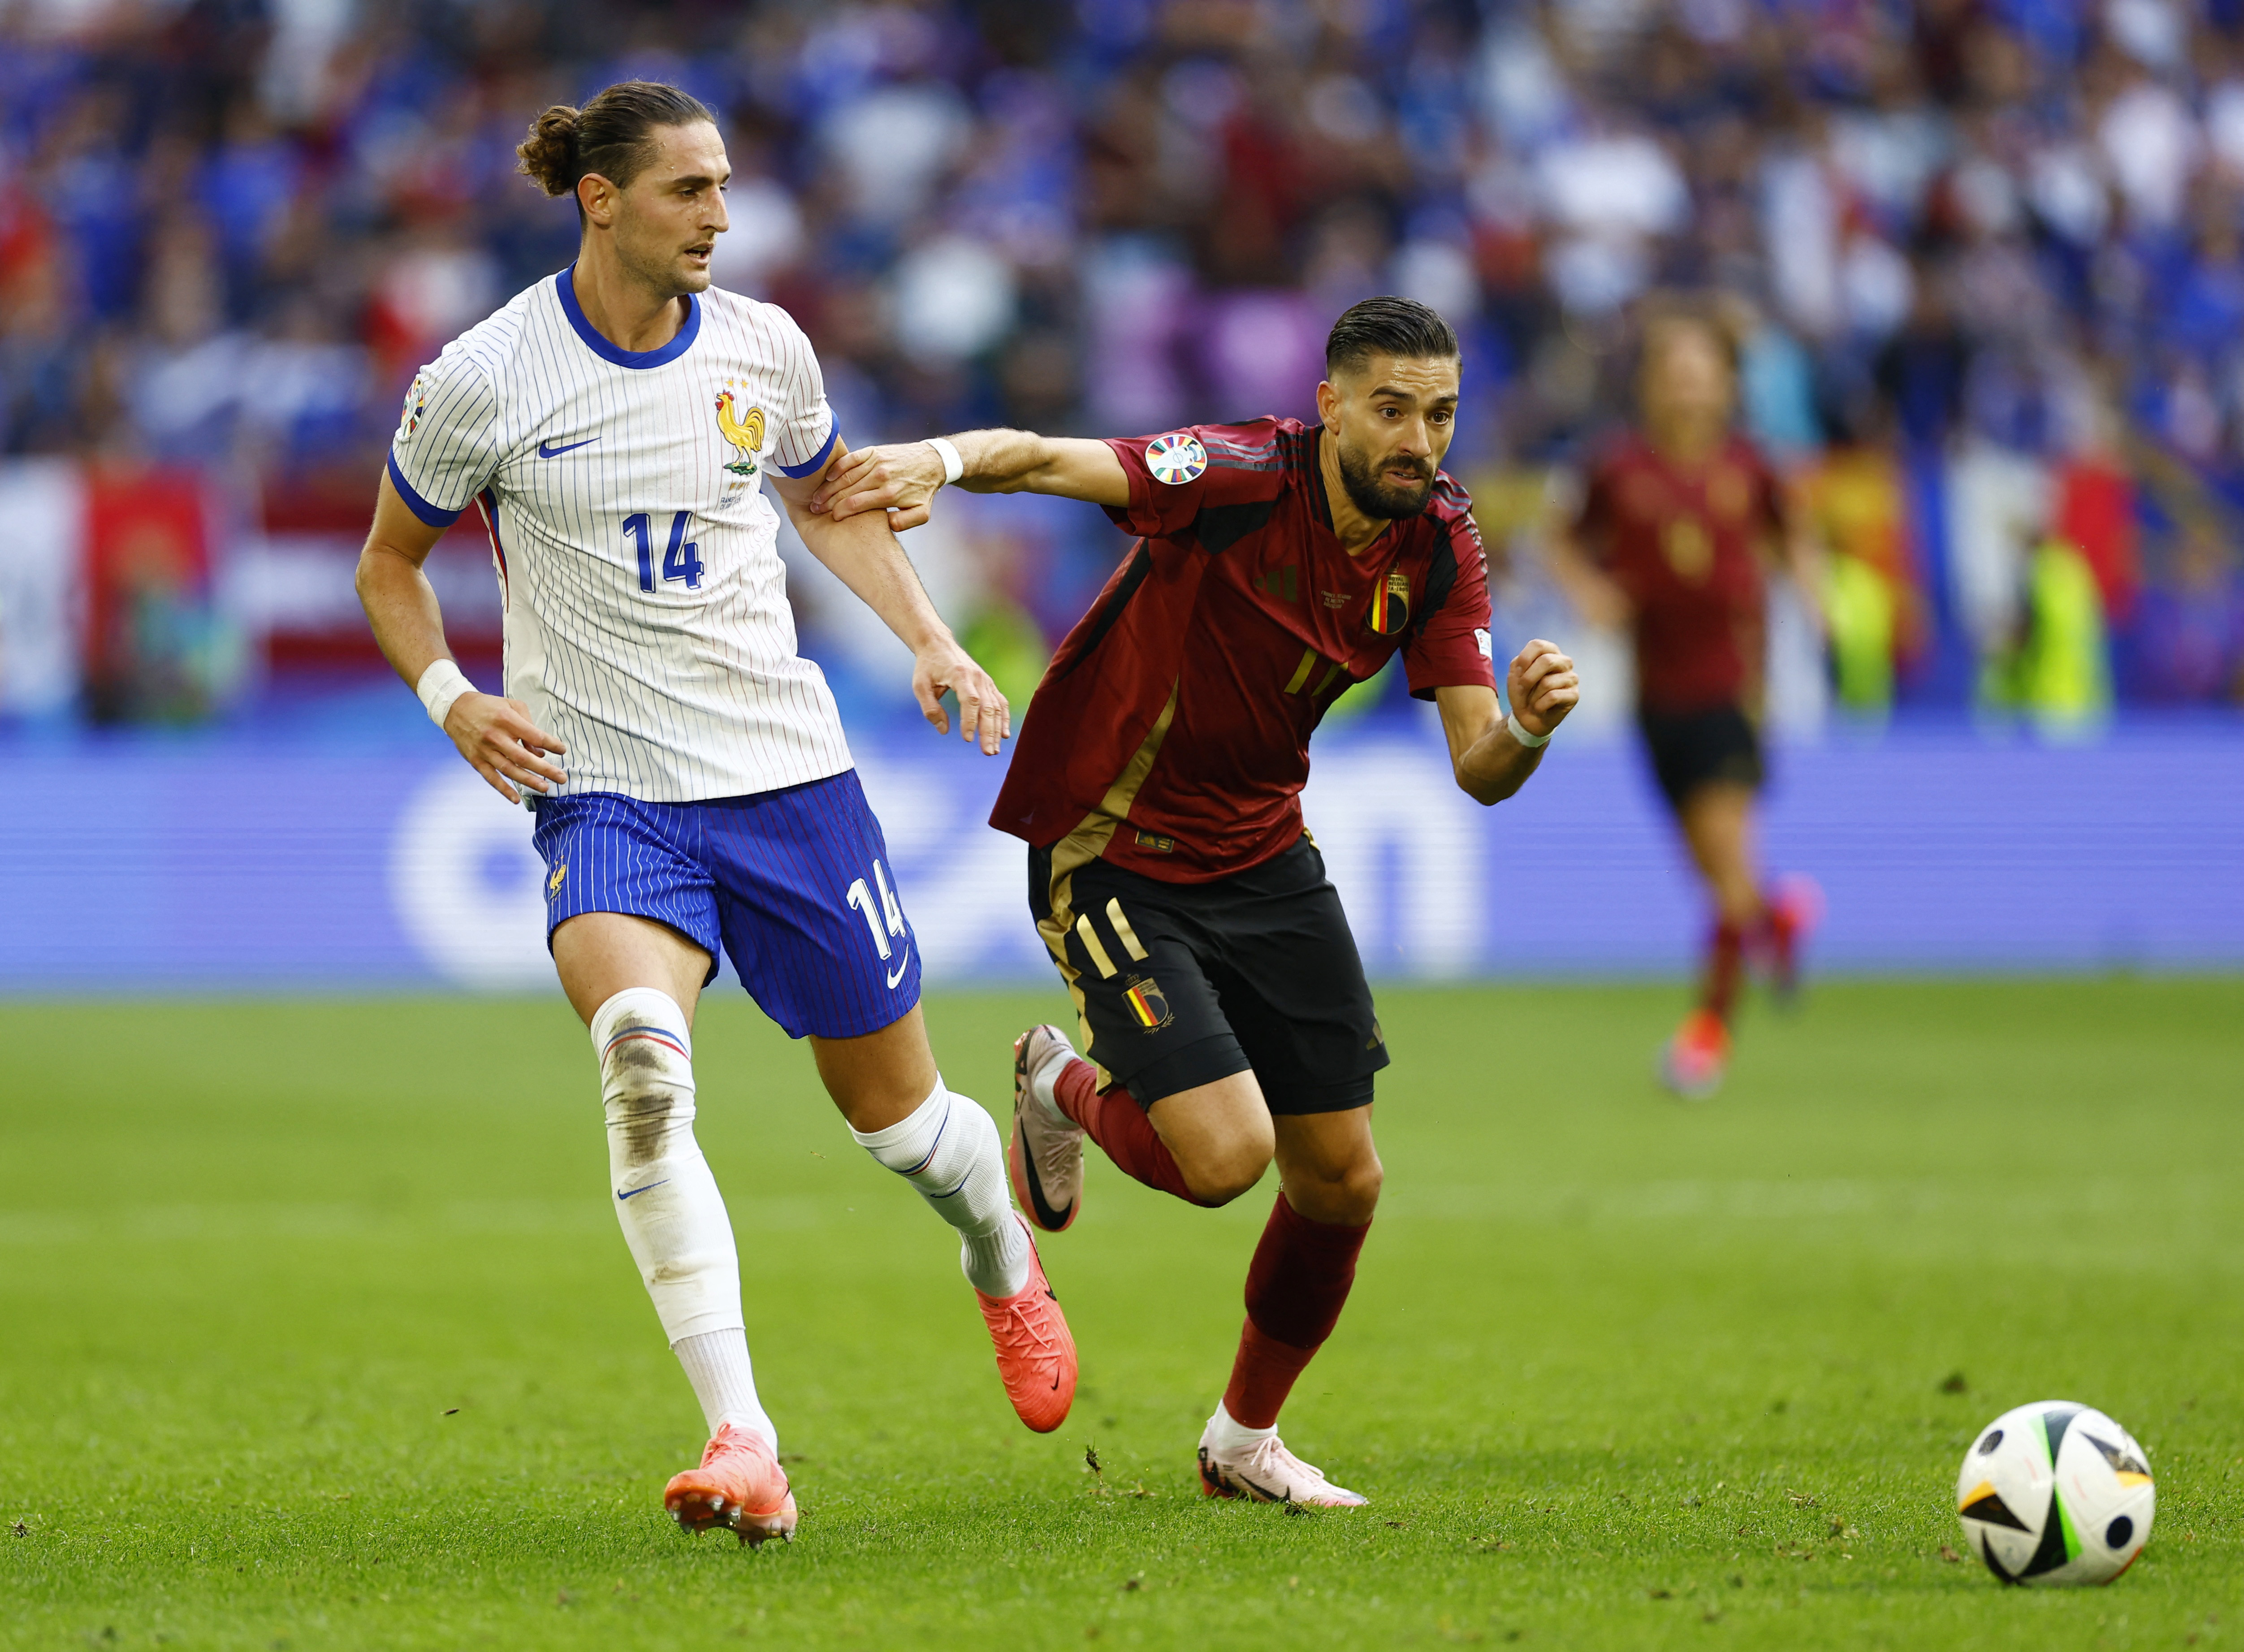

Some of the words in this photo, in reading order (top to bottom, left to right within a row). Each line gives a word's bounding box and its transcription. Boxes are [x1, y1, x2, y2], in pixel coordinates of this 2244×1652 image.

[623, 510, 705, 594] 14
[846, 859, 906, 960] 14
[1077, 897, 1149, 980] 11
